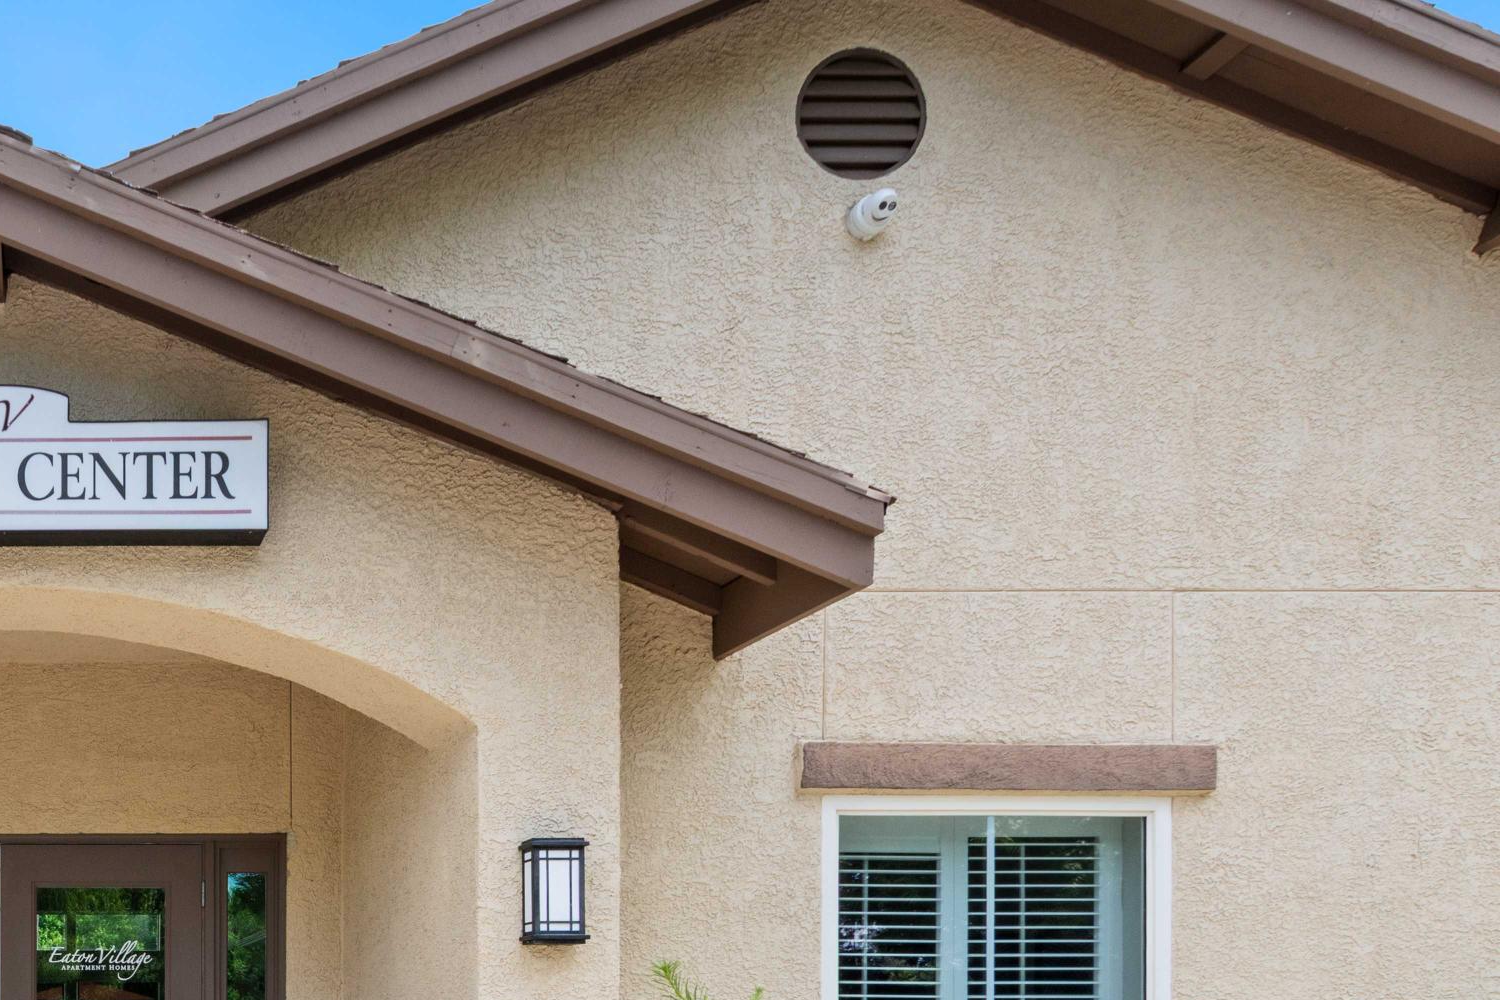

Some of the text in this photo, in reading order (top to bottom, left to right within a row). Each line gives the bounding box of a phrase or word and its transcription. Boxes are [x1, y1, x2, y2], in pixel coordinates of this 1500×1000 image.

[16, 450, 237, 502] CENTER
[48, 940, 153, 981] Eaton Village
